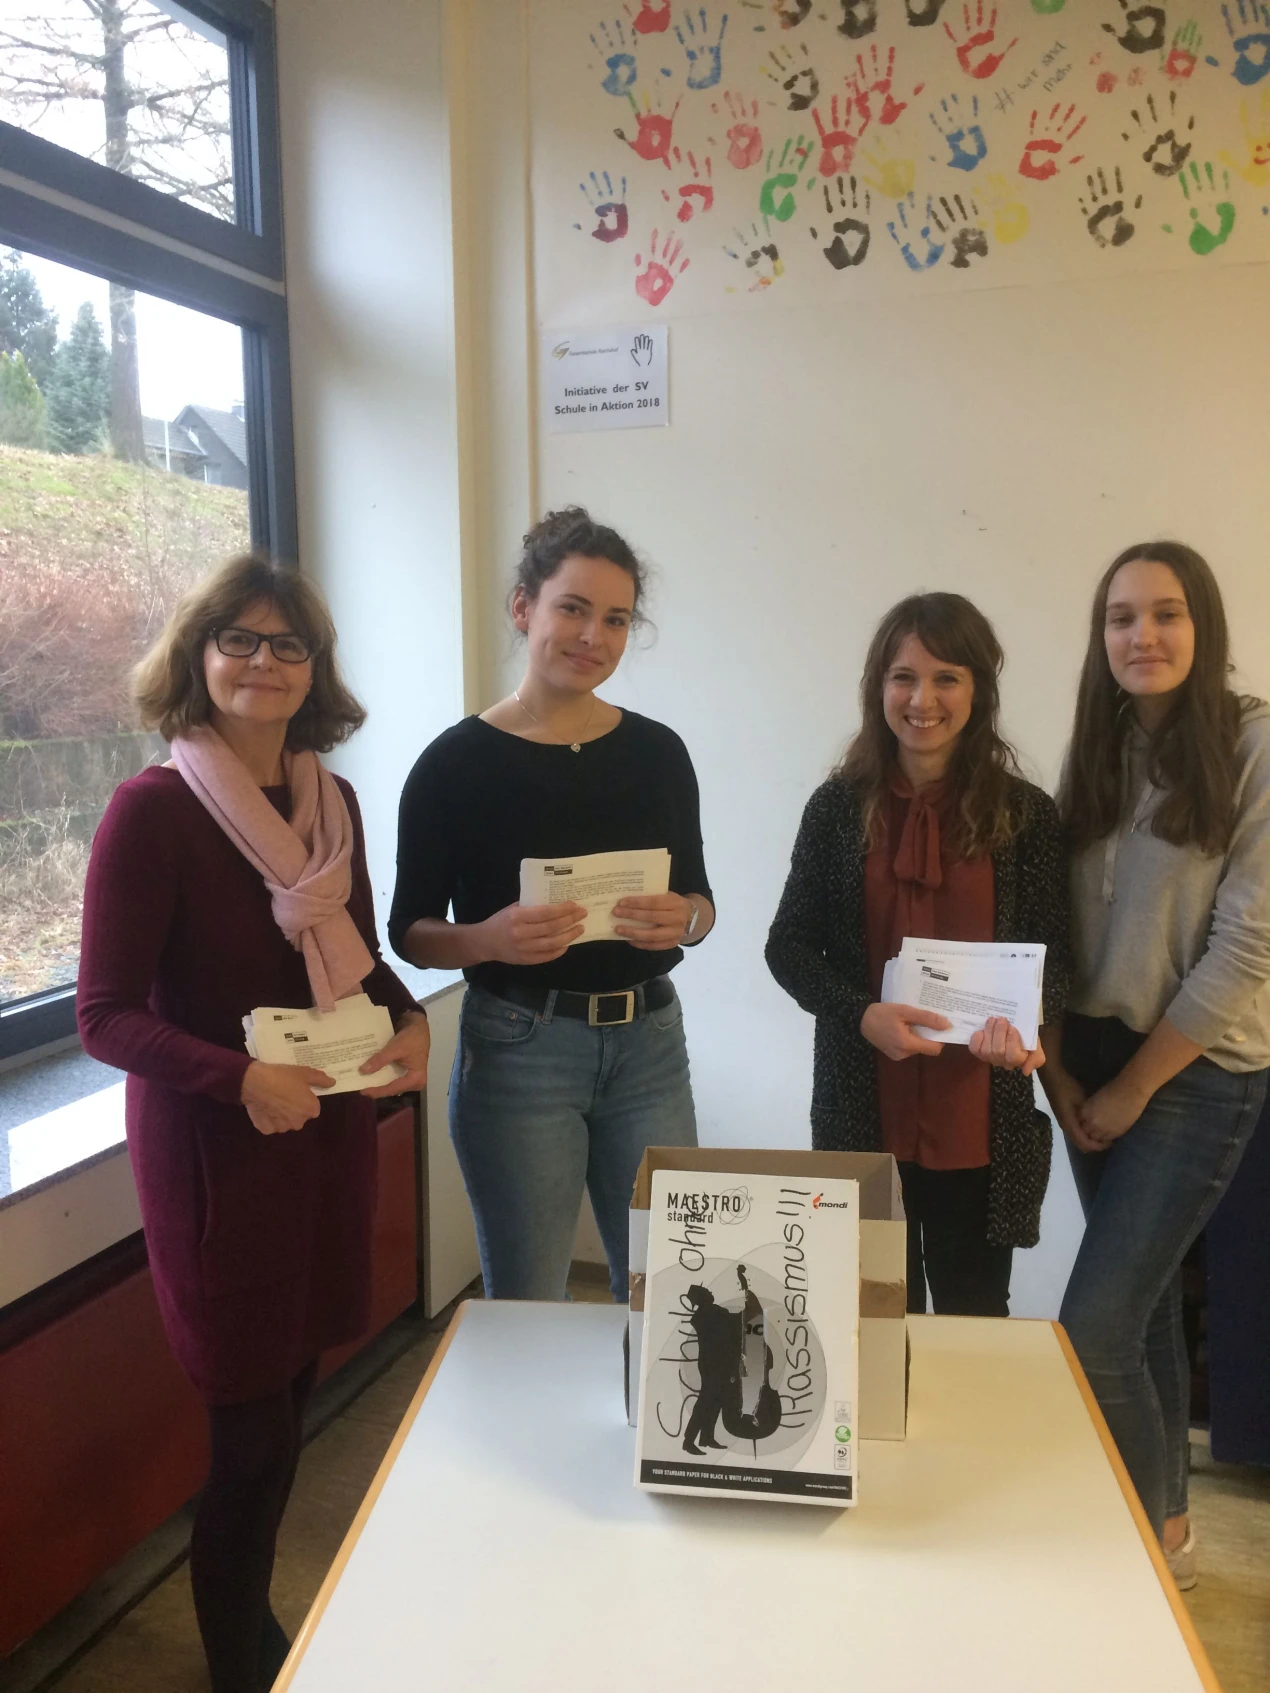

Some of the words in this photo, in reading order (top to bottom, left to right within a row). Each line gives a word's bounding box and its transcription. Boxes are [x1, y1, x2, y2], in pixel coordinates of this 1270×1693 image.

[564, 386, 608, 397] Initiative
[612, 384, 630, 393] der
[635, 381, 649, 391] SV
[554, 404, 586, 415] Schule
[589, 403, 598, 412] in
[601, 400, 634, 411] Aktion
[637, 397, 660, 409] 2018
[667, 1192, 741, 1213] MAESTRO
[667, 1210, 714, 1224] standard
[652, 1468, 664, 1476] YOUR
[664, 1469, 686, 1477] STANDARD
[743, 1476, 773, 1484] APPLICATIONS
